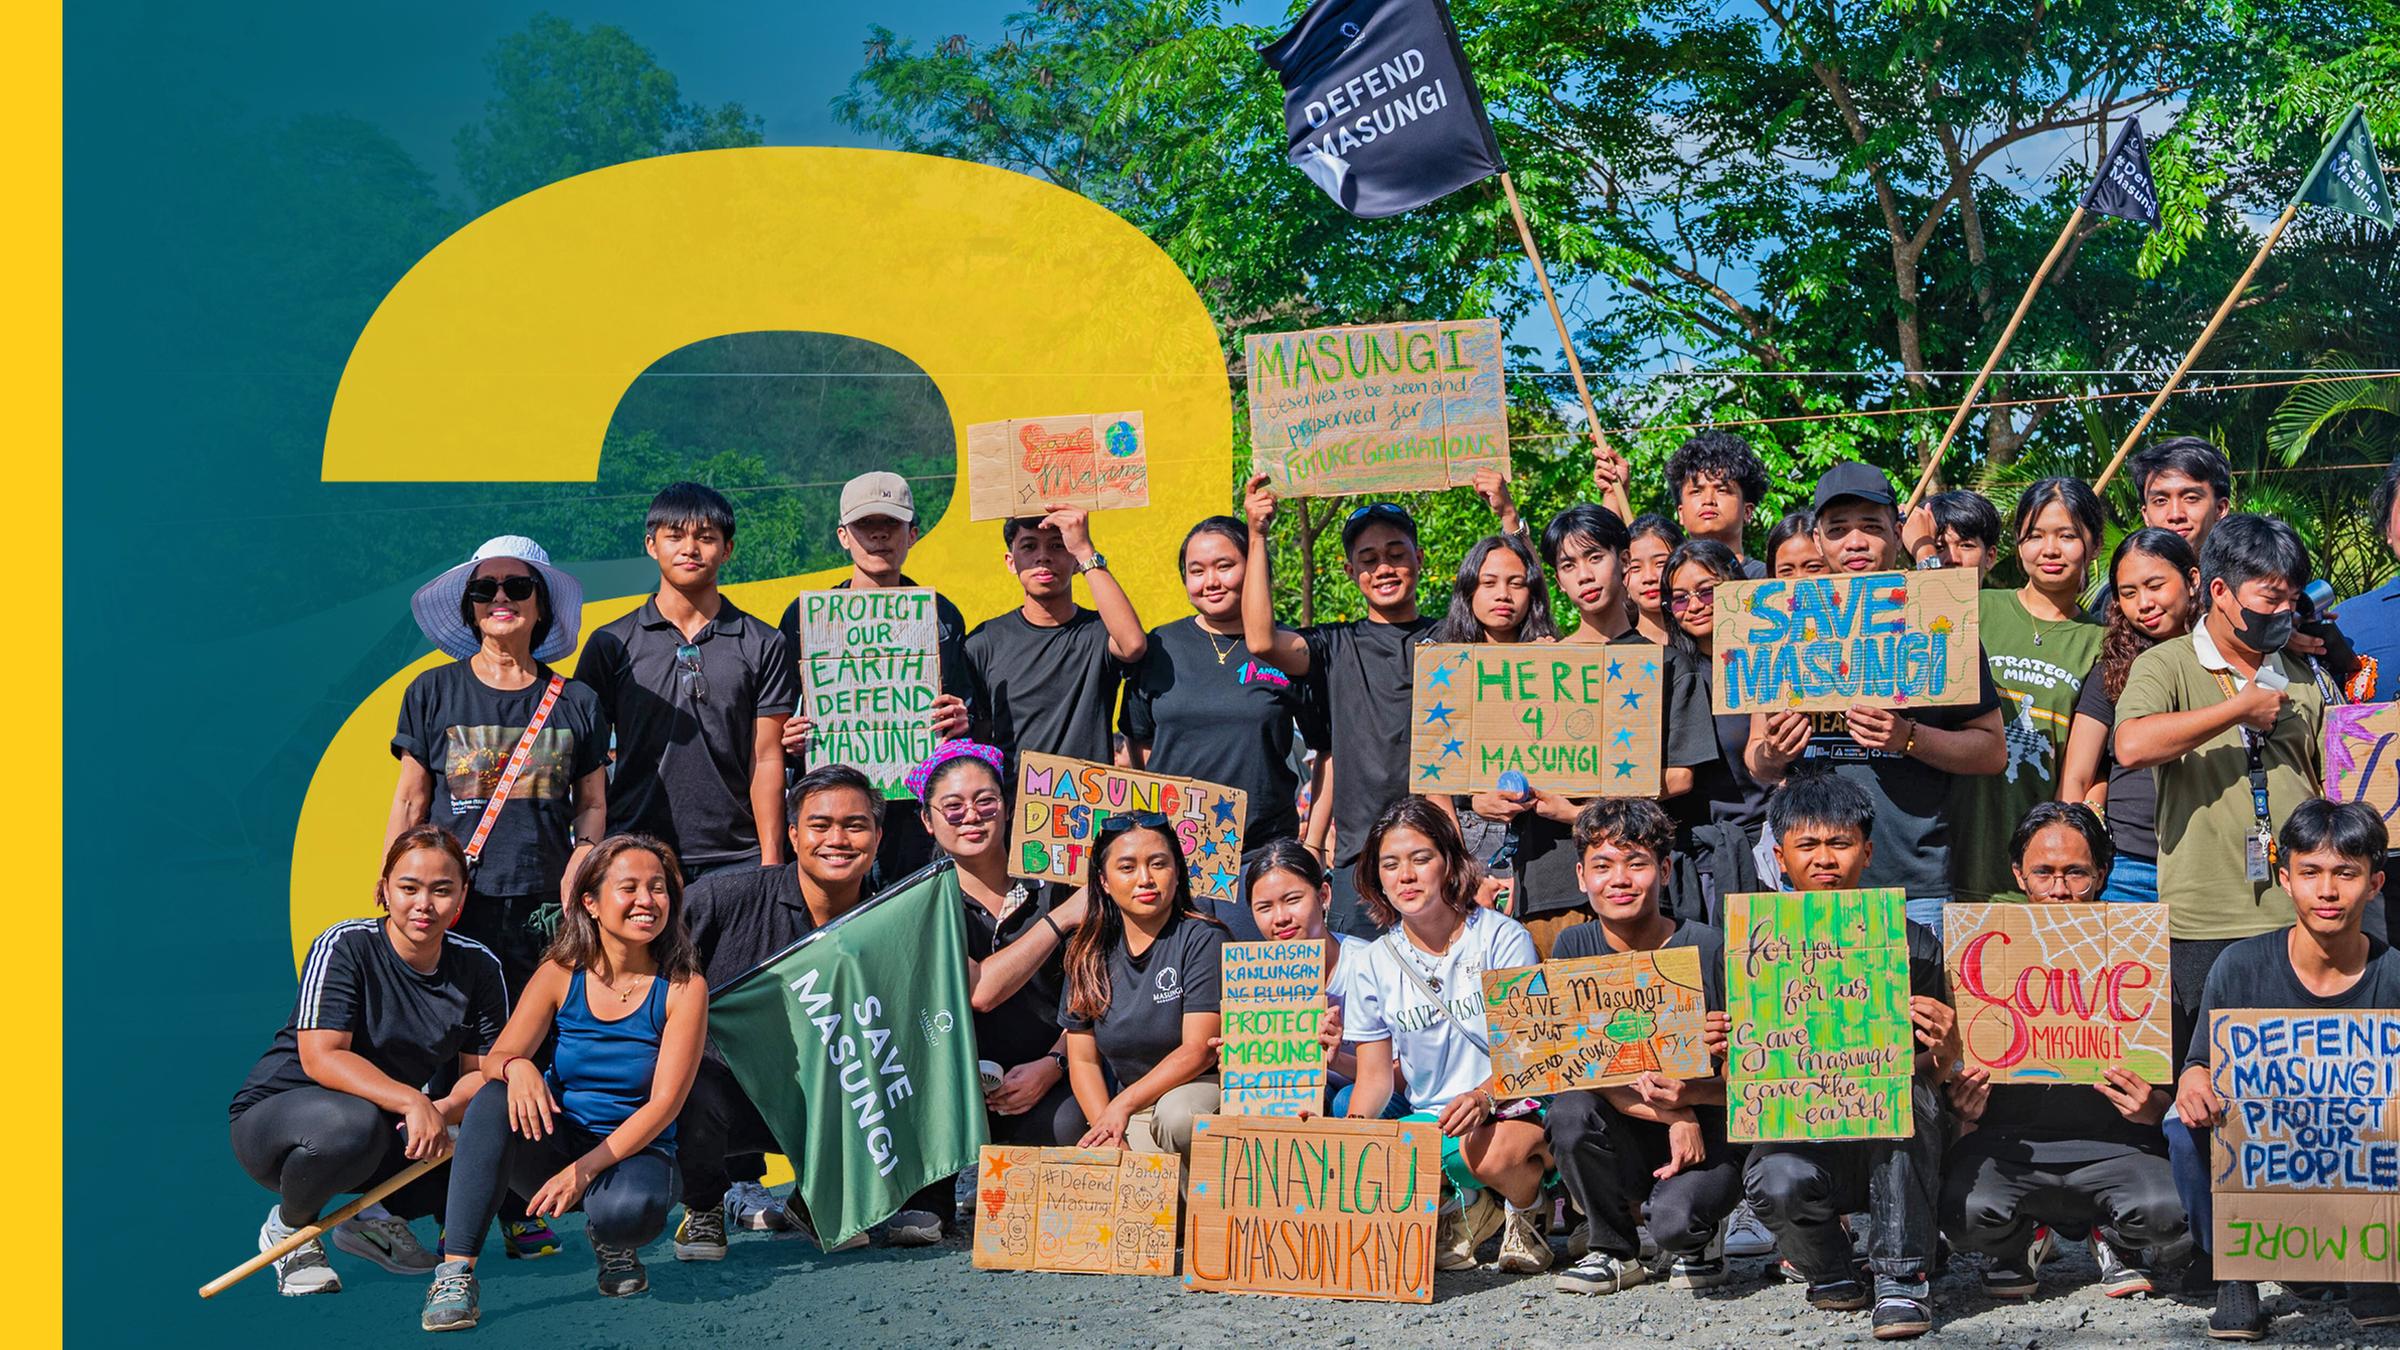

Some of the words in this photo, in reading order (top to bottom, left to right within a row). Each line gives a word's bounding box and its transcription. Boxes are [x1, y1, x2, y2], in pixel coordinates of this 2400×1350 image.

[1304, 49, 1425, 129] DEFEND
[1307, 79, 1448, 157] MASUNGI
[2109, 166, 2155, 219] Masungi
[2329, 159, 2381, 214] Masungi
[1256, 330, 1477, 394] MASUNGI
[1268, 389, 1337, 419] deserves
[1343, 385, 1360, 400] to
[1363, 382, 1382, 396] be
[1392, 382, 1427, 395] seen
[1431, 377, 1466, 395] and
[1287, 406, 1376, 448] preserved
[1389, 402, 1422, 430] for
[1282, 439, 1358, 485] FUTURE
[1360, 432, 1497, 467] GENERATIONS
[808, 595, 931, 623] PROTECT
[1748, 573, 1907, 644] SAVE
[847, 623, 893, 646] OUR
[811, 648, 925, 688] EARTH
[1257, 667, 1288, 680] ANGA
[1477, 659, 1600, 704] HERE
[1725, 631, 1947, 709] MASUNGI
[2003, 668, 2057, 689] MINDS
[816, 686, 935, 716] DEFEND
[811, 720, 936, 765] MASUNGI
[1521, 706, 1545, 740] 4
[1480, 744, 1598, 776] MASUNGI
[1026, 764, 1207, 821] MASUNGI
[1225, 943, 1321, 962] KALIKASAN
[1746, 920, 1793, 978] for
[1797, 939, 1845, 975] you
[1225, 964, 1320, 982] KANLUNGAN
[1153, 986, 1183, 1001] MASUNGI
[1784, 976, 1824, 1016] for
[1834, 978, 1870, 999] us
[1953, 930, 2152, 1069] Save
[1224, 1008, 1325, 1035] PROTECT
[853, 995, 913, 1109] SAVE
[1223, 1039, 1321, 1066] MASUNGI
[2031, 1026, 2122, 1059] MASUNGI
[789, 968, 899, 1177] MASUNGI
[1501, 1054, 1563, 1093] DEFEND
[1562, 1039, 1617, 1087] MASUNGI
[2232, 1057, 2393, 1099] MASUNGI
[1223, 1069, 1322, 1103] PROTECT
[1806, 1074, 1862, 1099] the
[1797, 1092, 1888, 1125] earth
[2242, 1097, 2385, 1135] PROTECT
[2295, 1126, 2360, 1149] OUR
[1042, 1168, 1113, 1192] #Defend
[2243, 1142, 2398, 1188] PEOPLE
[1046, 1192, 1111, 1217] Masungi
[2224, 1222, 2347, 1262] MORE
